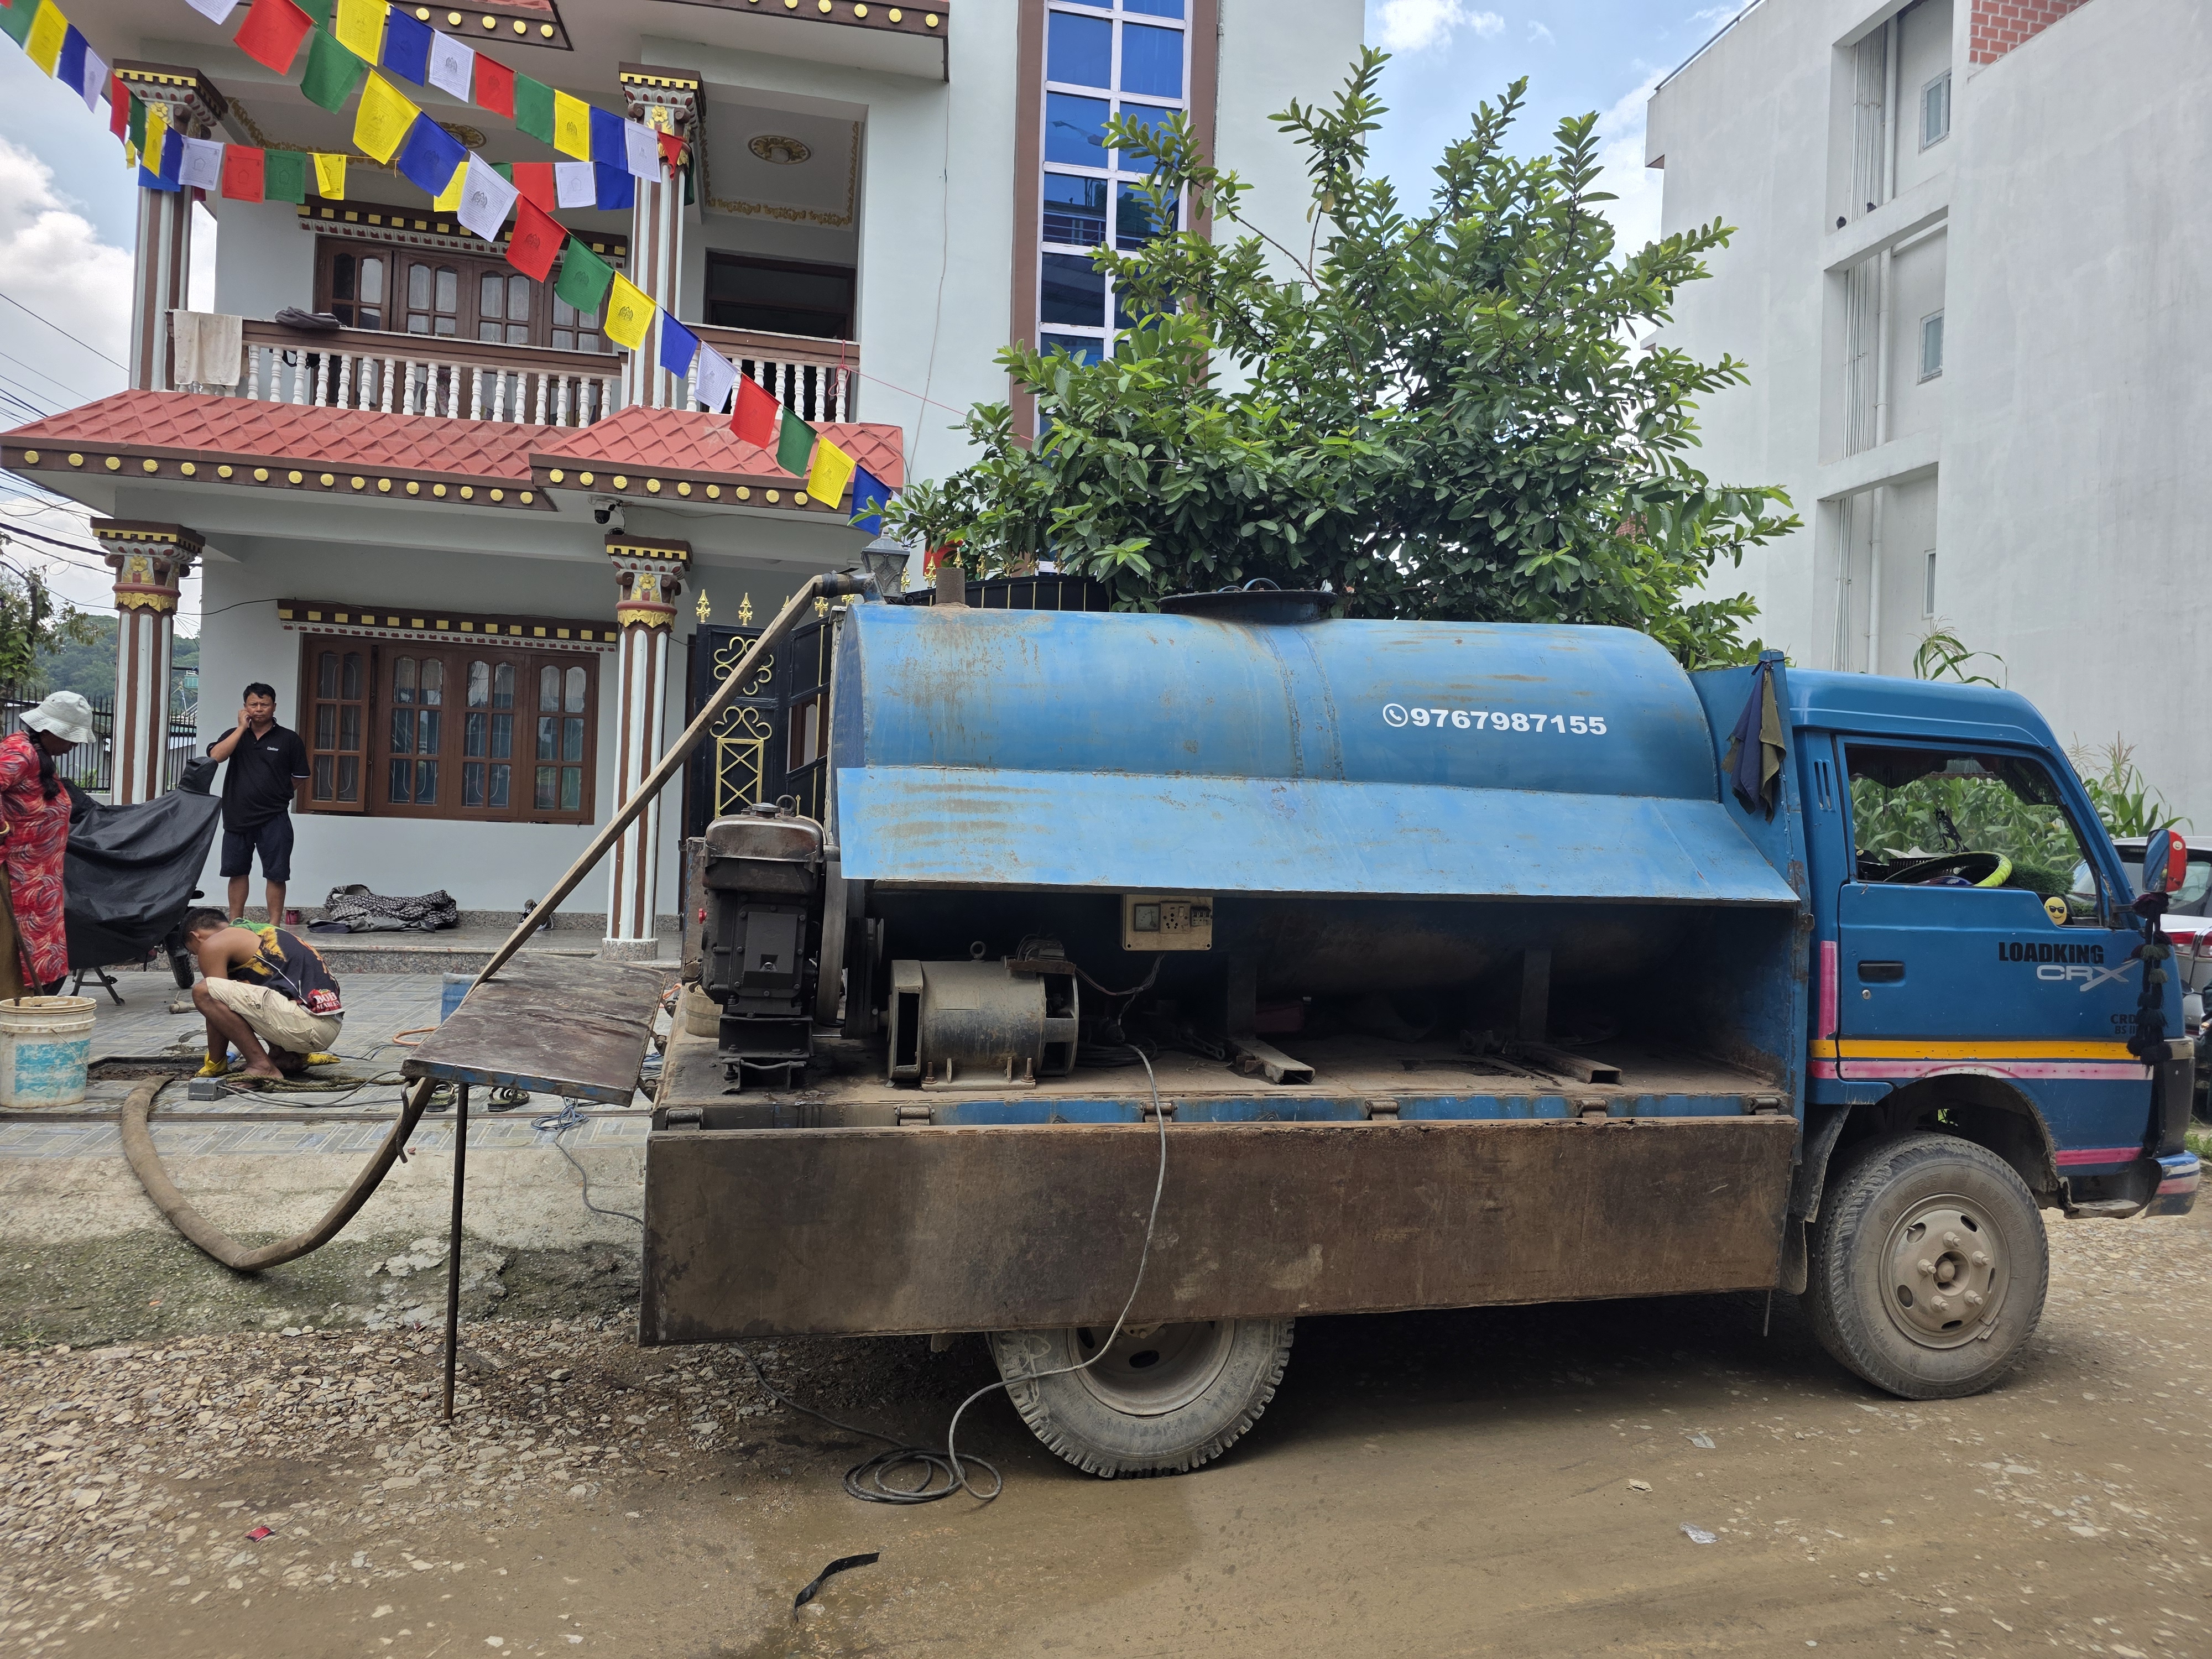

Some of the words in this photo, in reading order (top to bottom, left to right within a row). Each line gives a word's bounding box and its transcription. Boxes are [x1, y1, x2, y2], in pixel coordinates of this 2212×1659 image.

[1410, 708, 1607, 735] 9767987155
[1999, 942, 2104, 964] LOADKING
[2037, 959, 2138, 992] CRX
[313, 992, 337, 1005] BOB
[2115, 1025, 2126, 1035] BS
